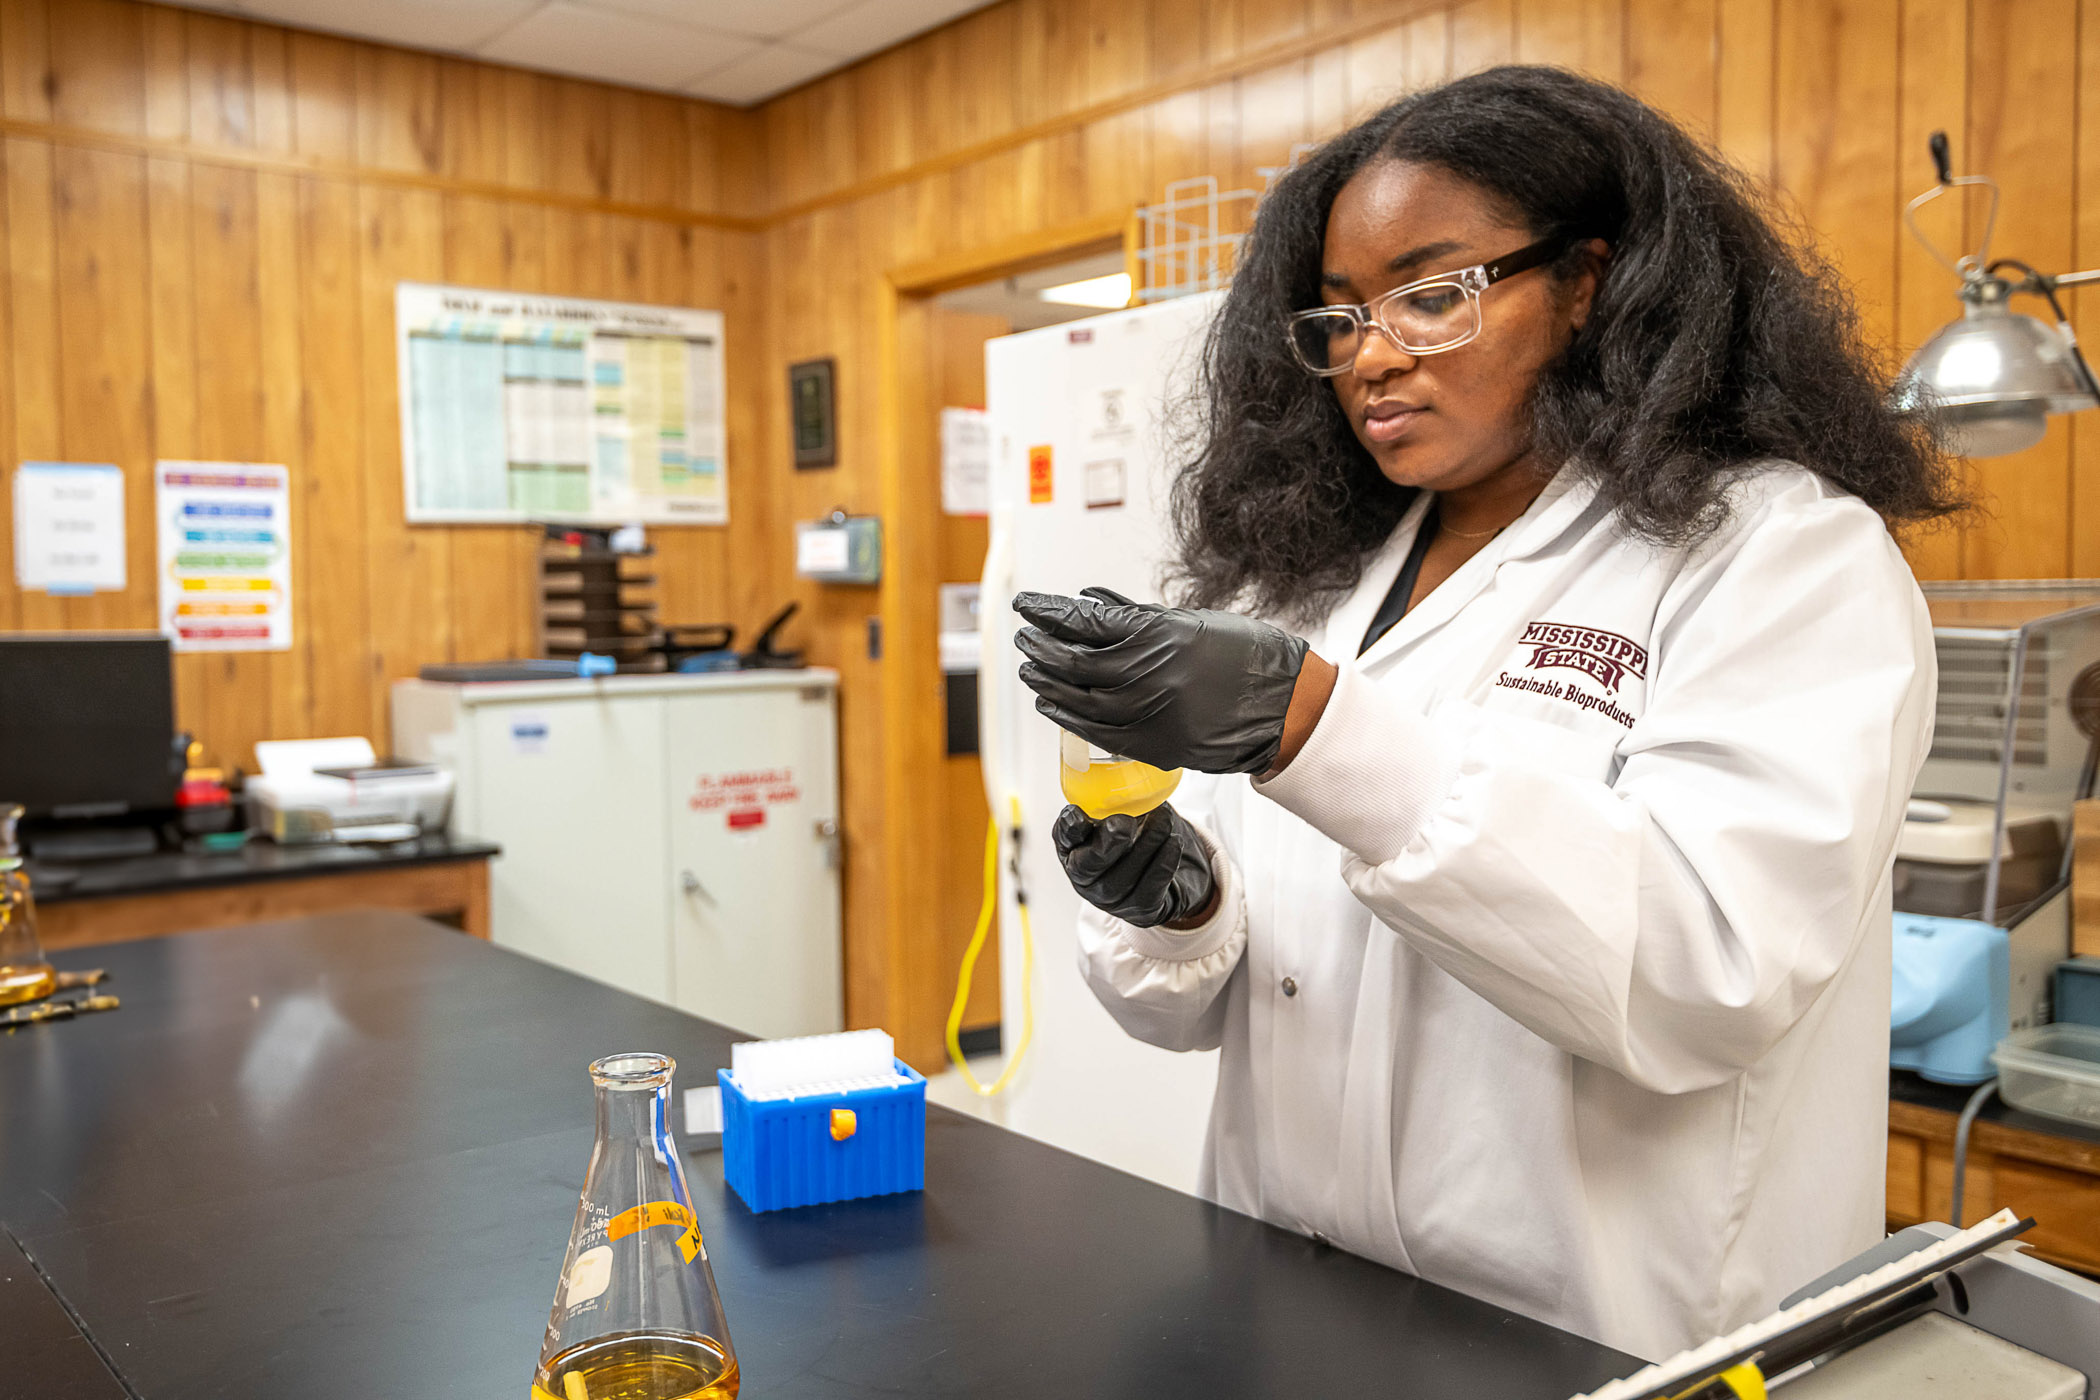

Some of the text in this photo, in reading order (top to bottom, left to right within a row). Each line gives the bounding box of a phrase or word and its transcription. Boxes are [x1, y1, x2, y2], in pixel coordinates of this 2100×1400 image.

[1544, 651, 1608, 683] STATE
[1496, 672, 1636, 730] Sustainable Bioproducts
[596, 1205, 610, 1216] mL
